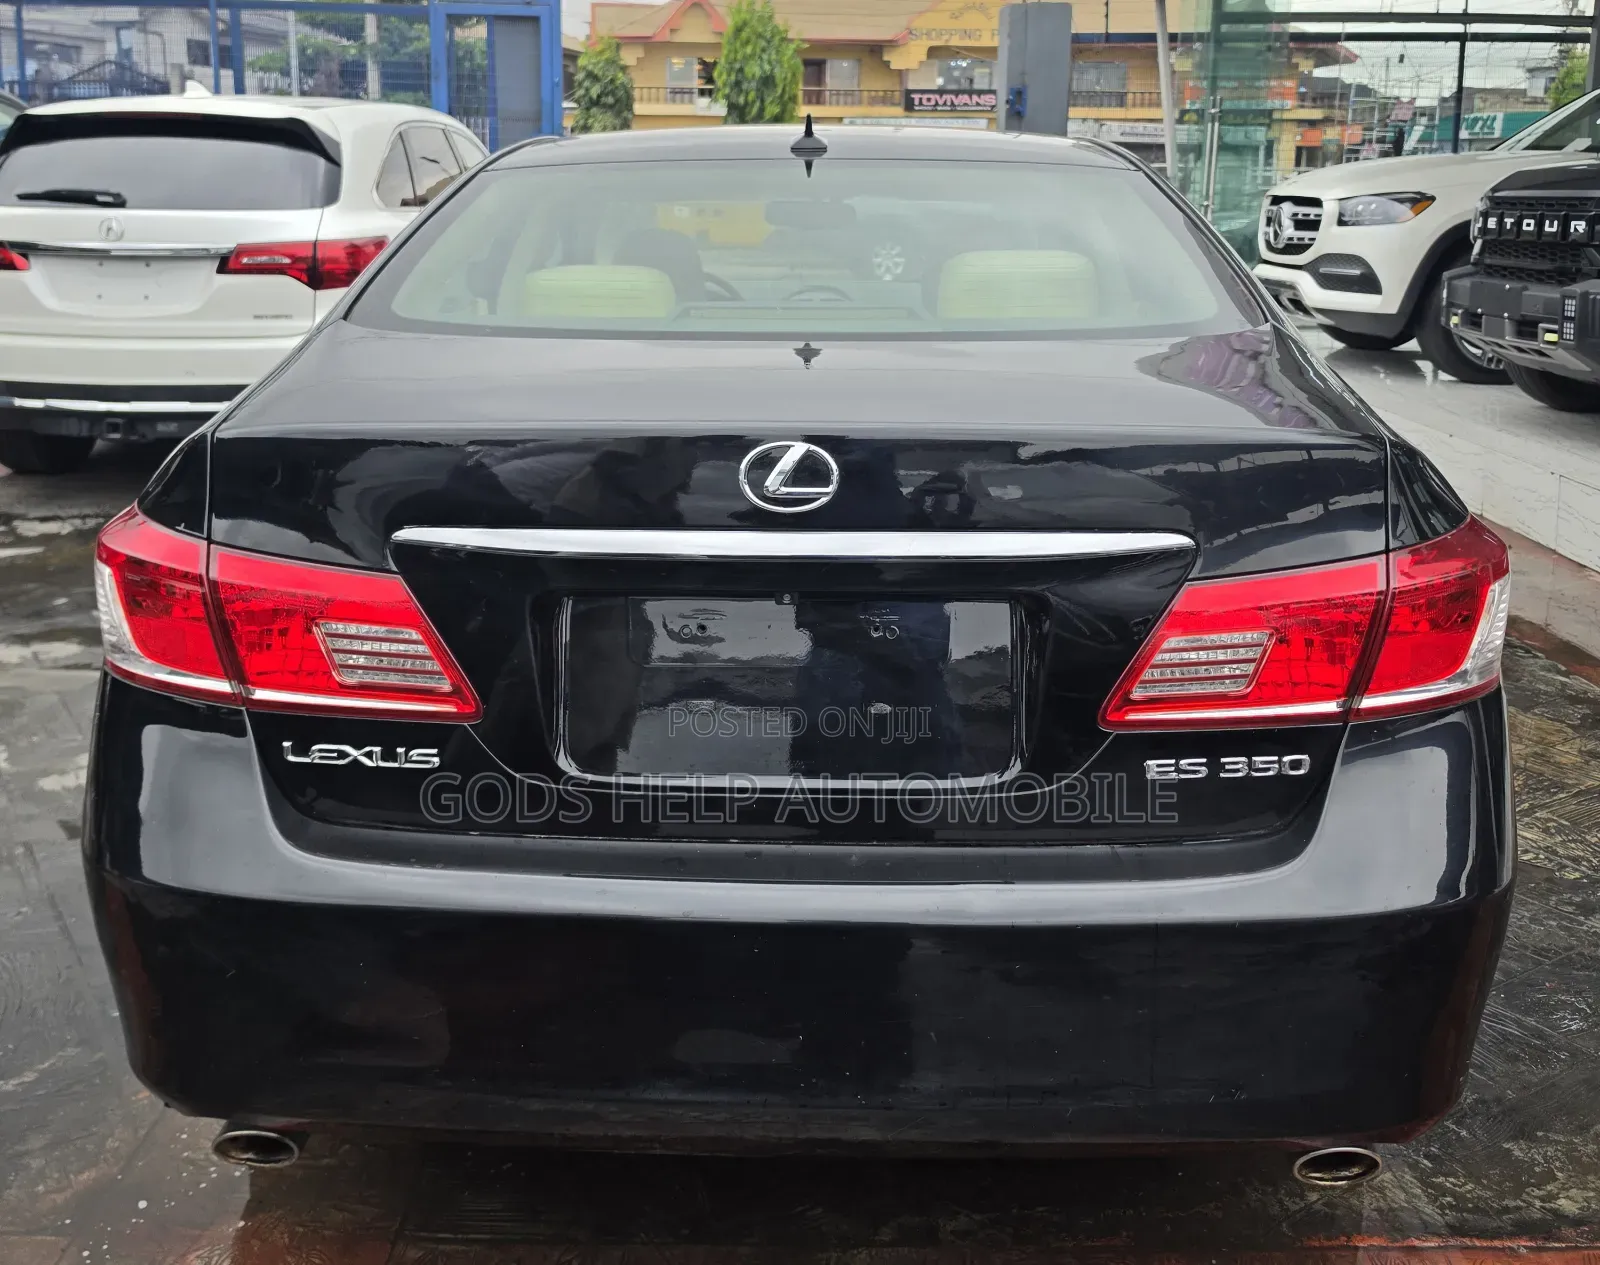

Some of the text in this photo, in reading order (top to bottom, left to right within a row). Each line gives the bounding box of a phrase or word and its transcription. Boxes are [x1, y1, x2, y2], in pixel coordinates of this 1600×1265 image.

[909, 27, 982, 41] SHOPPING
[910, 93, 996, 106] TOVIVANS
[1475, 216, 1587, 233] JETOUR
[282, 741, 440, 768] LEXUS
[1144, 754, 1310, 779] ES 350
